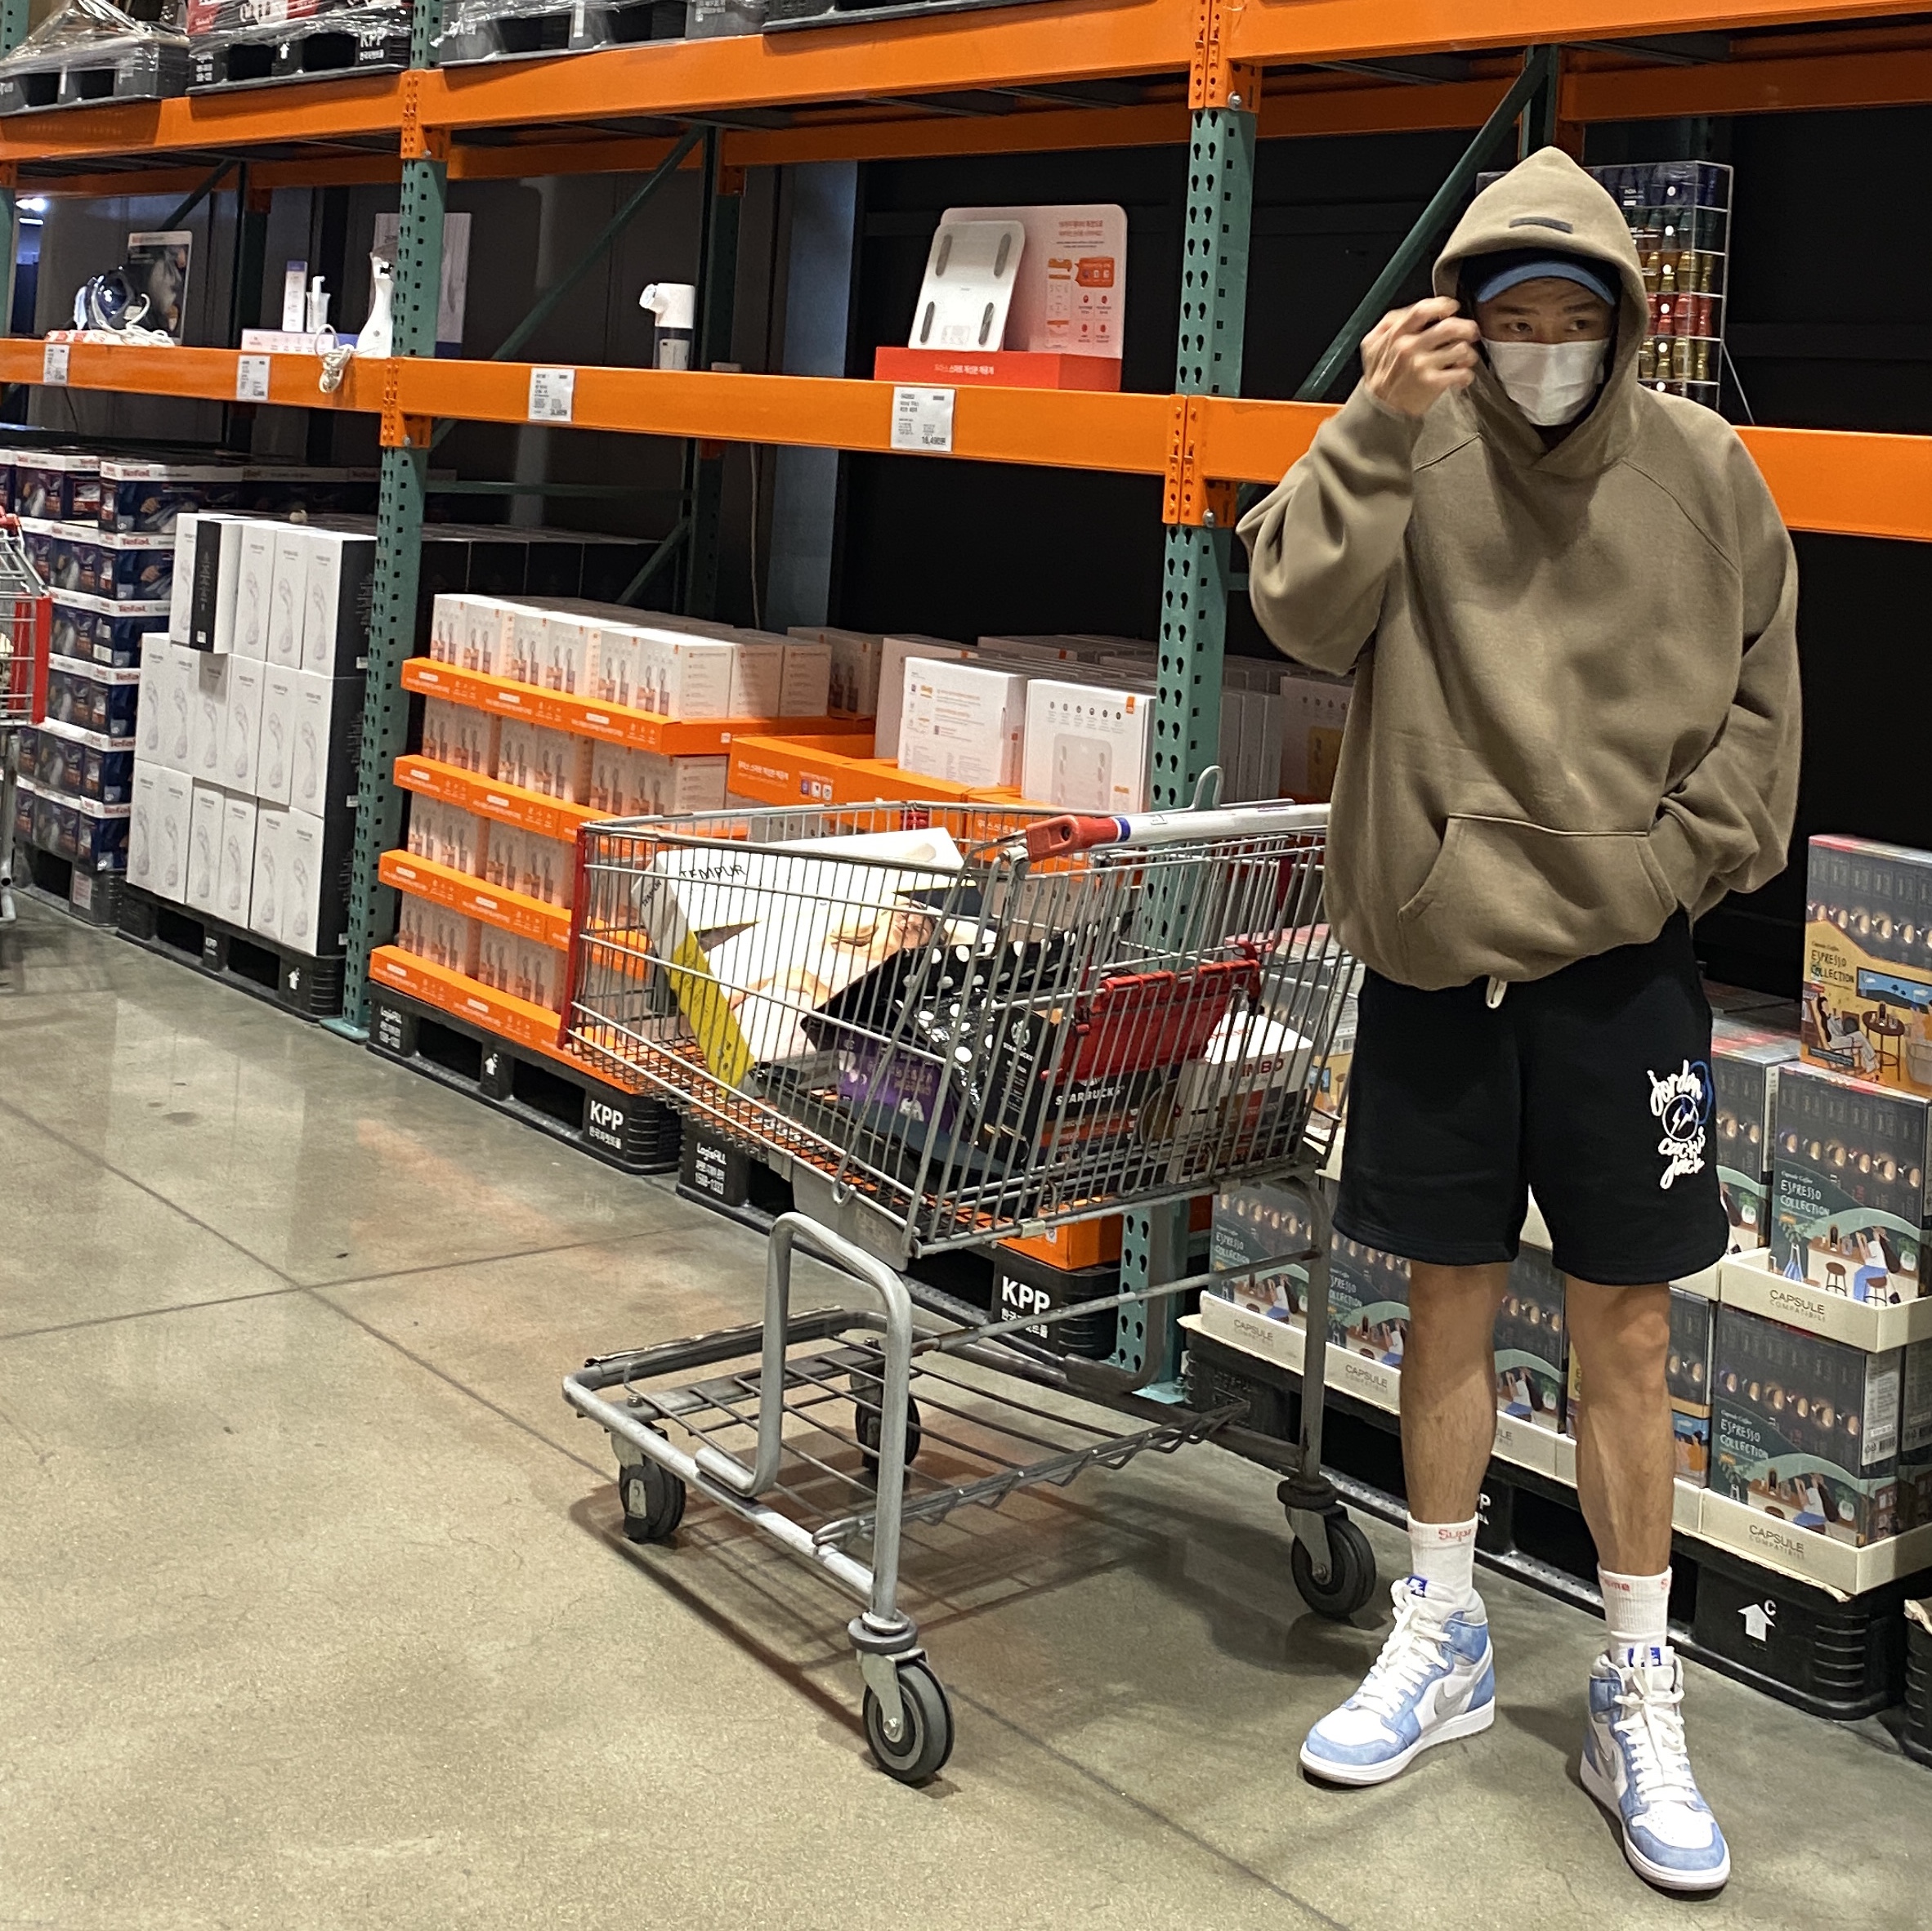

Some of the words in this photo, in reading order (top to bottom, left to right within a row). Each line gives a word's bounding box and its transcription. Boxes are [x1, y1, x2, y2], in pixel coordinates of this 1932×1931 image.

[123, 469, 150, 477] Tefal
[122, 537, 150, 546] Tefal
[1811, 950, 1847, 968] ESPRESSO
[590, 1100, 624, 1131] KPP
[1780, 1179, 1822, 1201] ESPRESSO
[1779, 1195, 1831, 1217] COLLECTION
[1001, 1275, 1051, 1315] KPP
[1329, 1274, 1357, 1294] SPRESSO
[1769, 1290, 1825, 1315] CAPSULE
[1233, 1318, 1274, 1341] CAPSULE
[1345, 1364, 1388, 1388] CAPSULE
[1720, 1419, 1761, 1443] ESPRESSO
[1720, 1434, 1769, 1460] COLLECTION
[1749, 1524, 1805, 1553] CAPSULE
[1764, 1599, 1777, 1616] C
